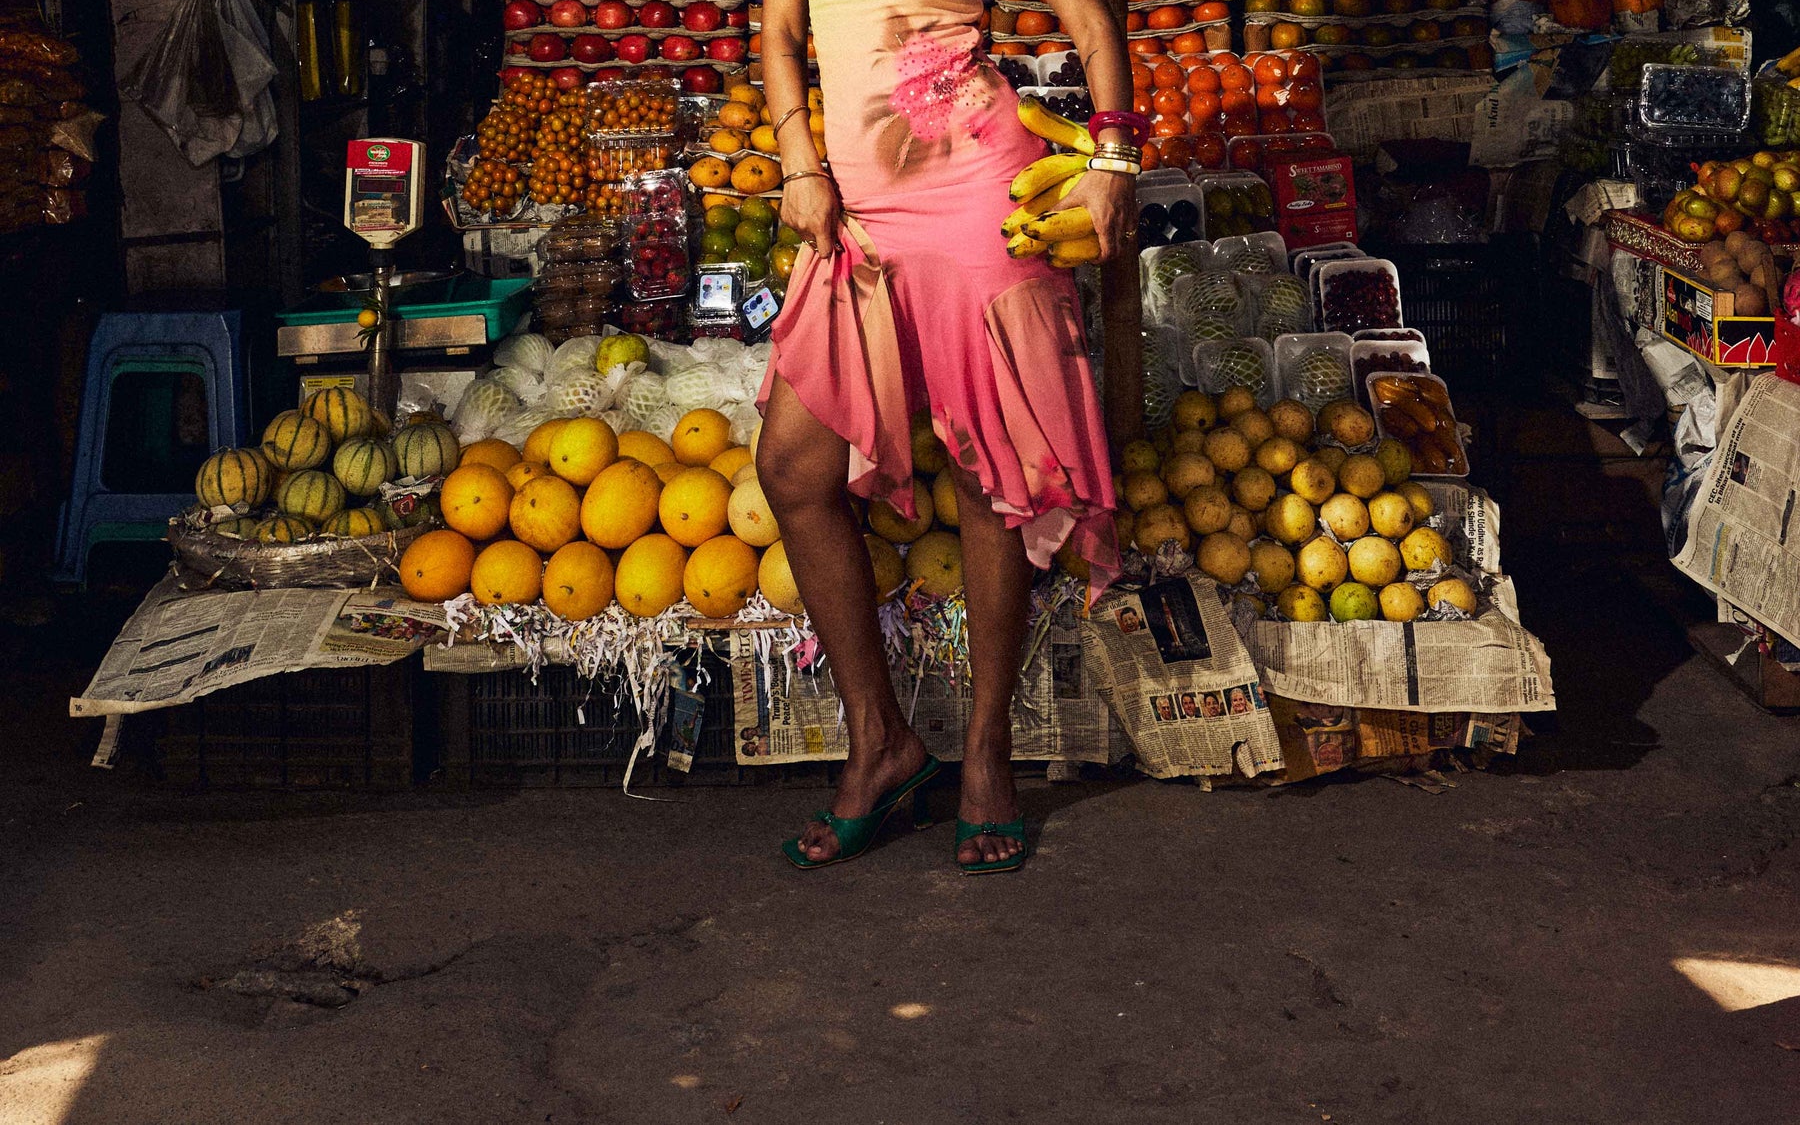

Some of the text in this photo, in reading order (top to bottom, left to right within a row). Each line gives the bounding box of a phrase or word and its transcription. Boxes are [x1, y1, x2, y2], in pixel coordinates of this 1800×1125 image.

[1708, 487, 1718, 503] CEC
[1714, 469, 1725, 488] cites
[1722, 440, 1734, 469] success
[1718, 477, 1729, 496] Bihar
[1729, 442, 1738, 466] global
[1735, 422, 1746, 441] meet
[740, 661, 753, 703] TIMES
[771, 691, 781, 720] Trump's
[782, 700, 791, 725] Peace'
